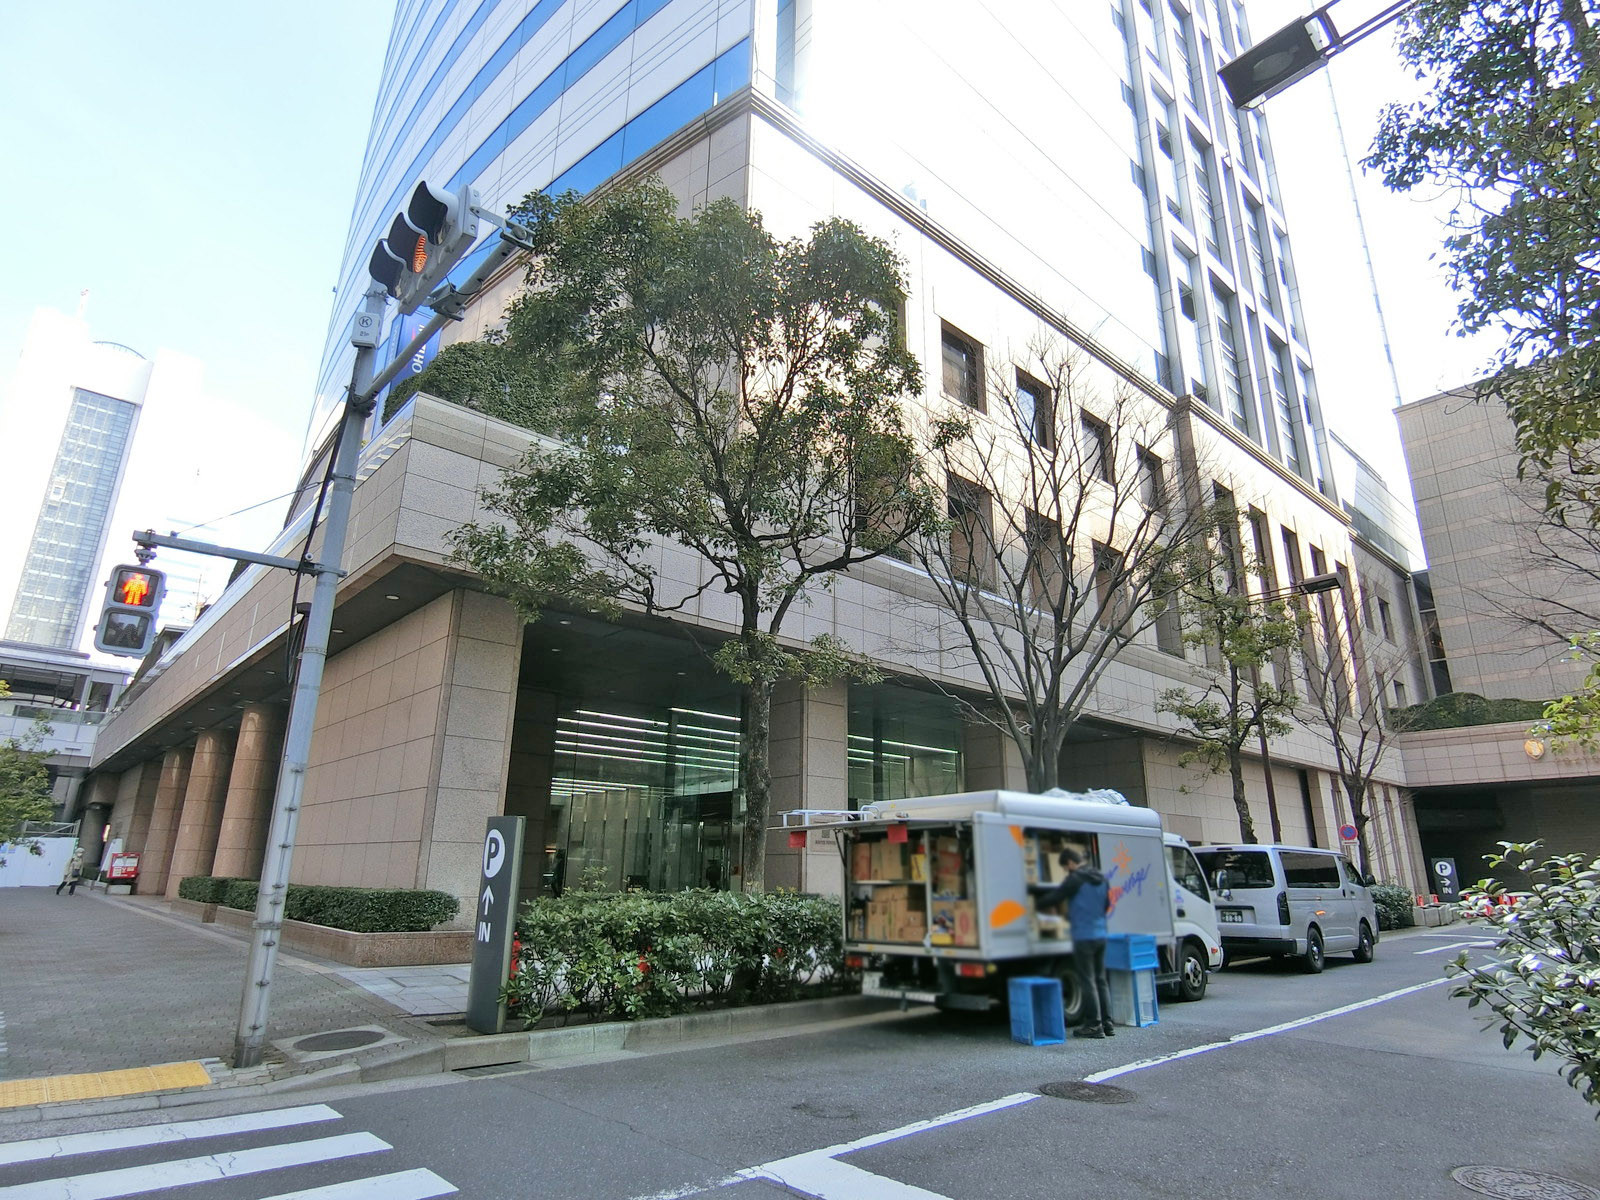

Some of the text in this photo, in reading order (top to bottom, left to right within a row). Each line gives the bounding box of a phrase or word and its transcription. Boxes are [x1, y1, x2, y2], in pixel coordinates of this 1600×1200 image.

[486, 837, 500, 870] P
[1439, 863, 1448, 873] P
[478, 921, 492, 943] IN
